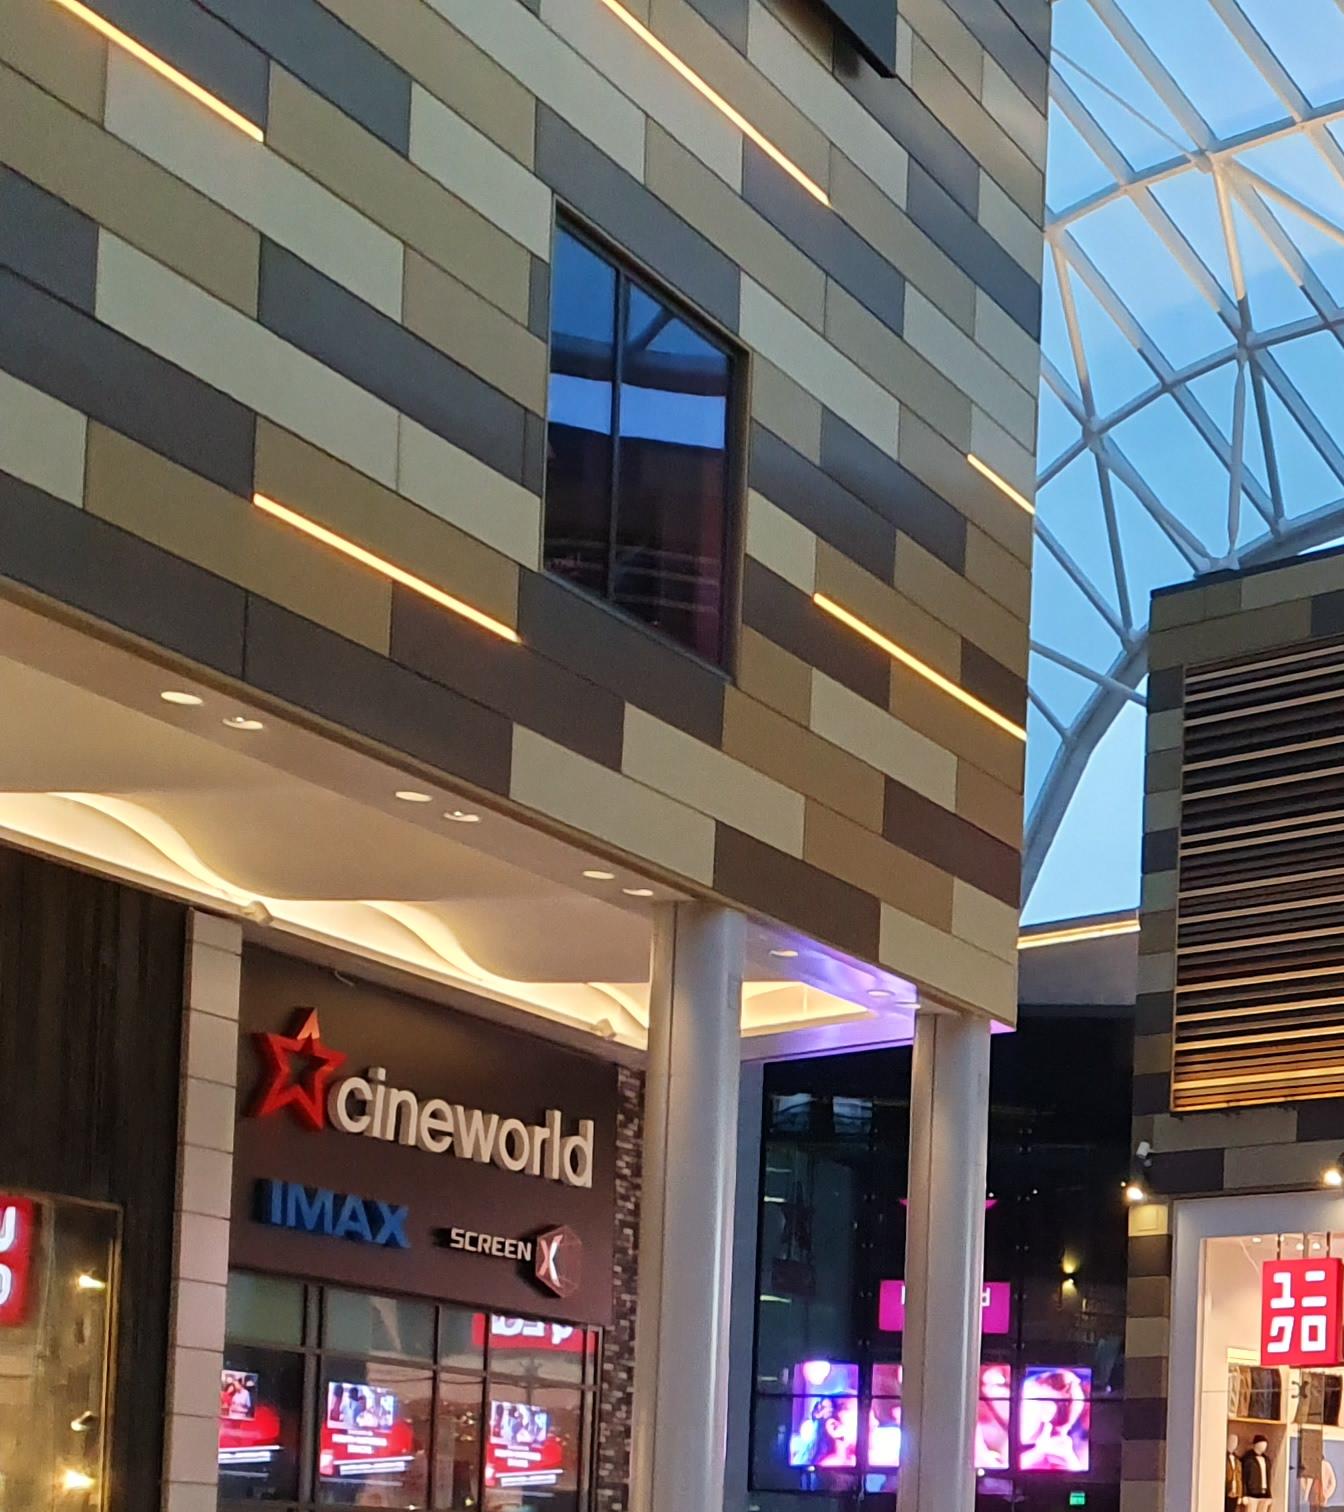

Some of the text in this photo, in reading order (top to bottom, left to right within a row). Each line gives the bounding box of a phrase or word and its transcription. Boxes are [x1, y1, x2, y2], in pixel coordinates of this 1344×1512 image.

[328, 1066, 595, 1189] cineworld
[270, 1179, 412, 1249] IMAX
[450, 1227, 532, 1262] SCREEN
